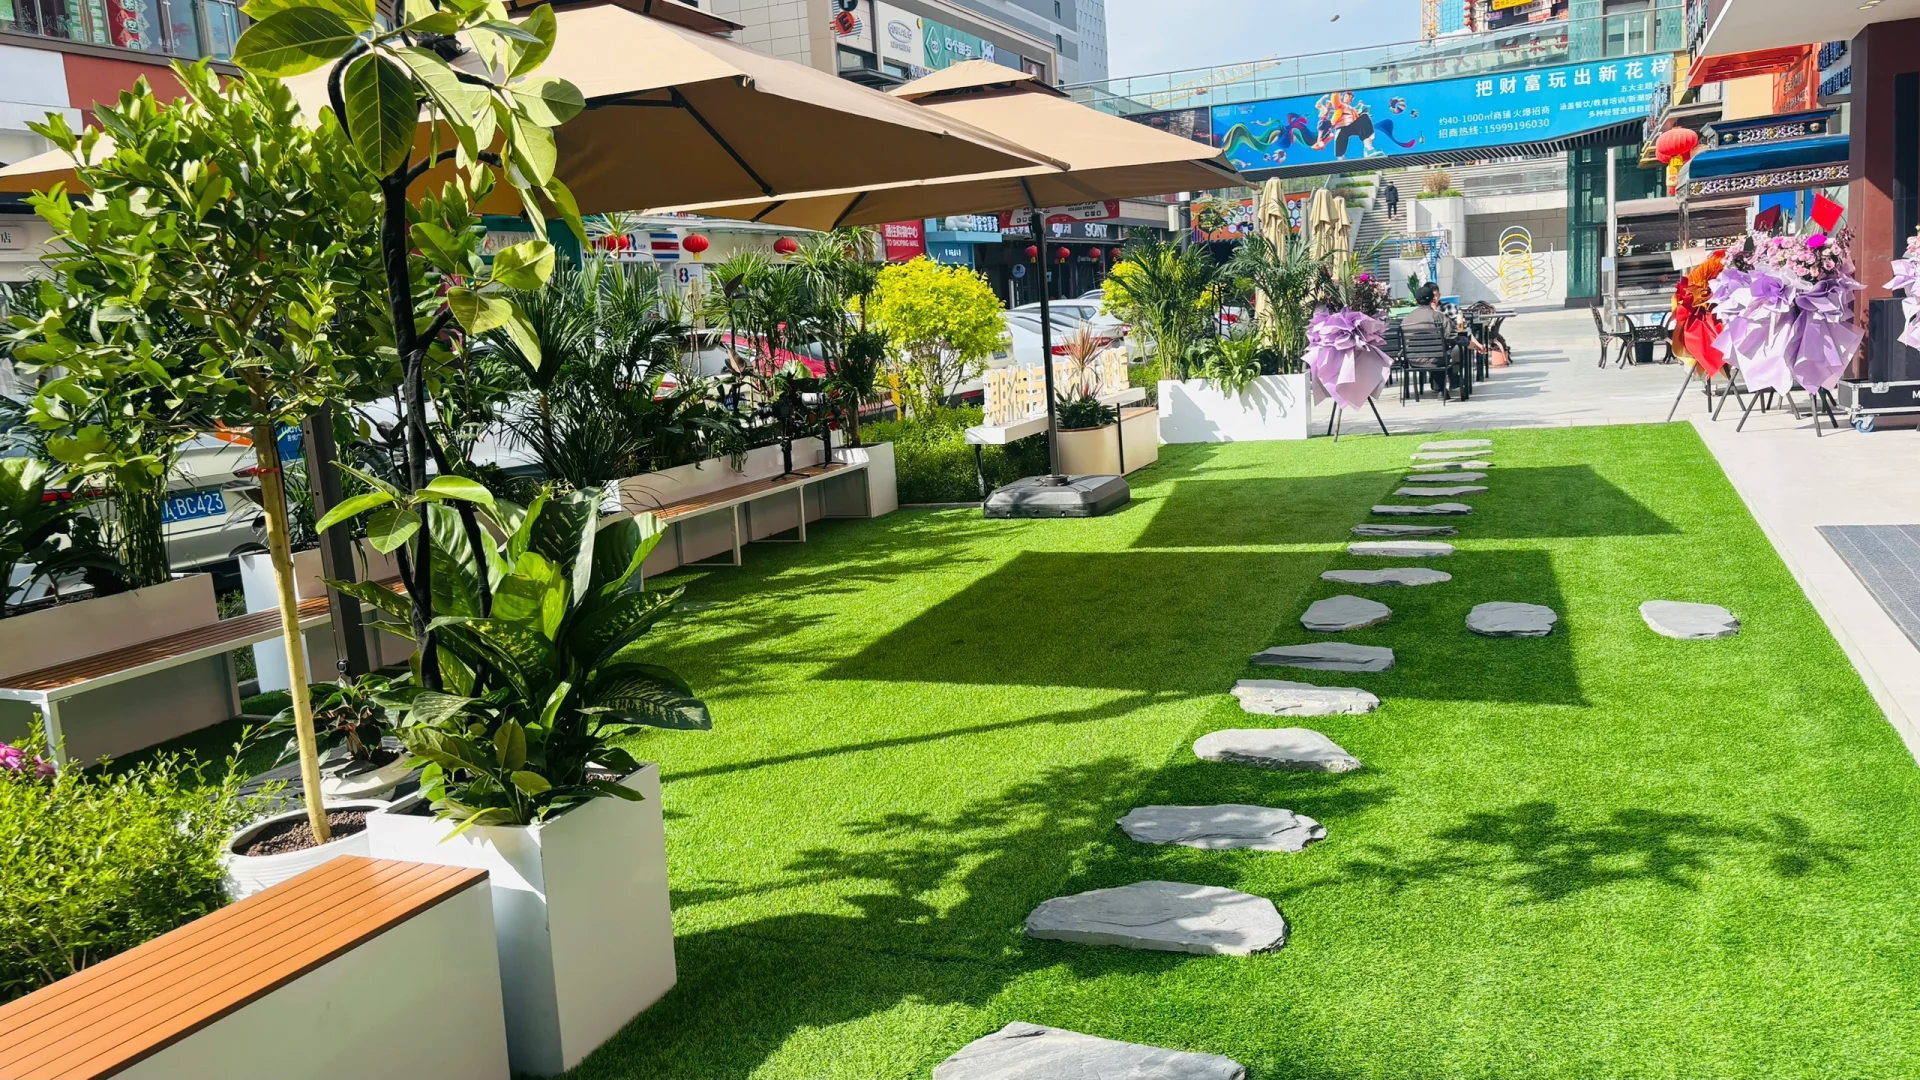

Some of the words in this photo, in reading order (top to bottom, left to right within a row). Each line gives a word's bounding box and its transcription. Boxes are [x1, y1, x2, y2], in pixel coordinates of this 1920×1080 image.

[1475, 58, 1668, 98] 把财富玩出新花样
[1513, 105, 1550, 118] 火爆招商
[1084, 222, 1107, 237] SONY
